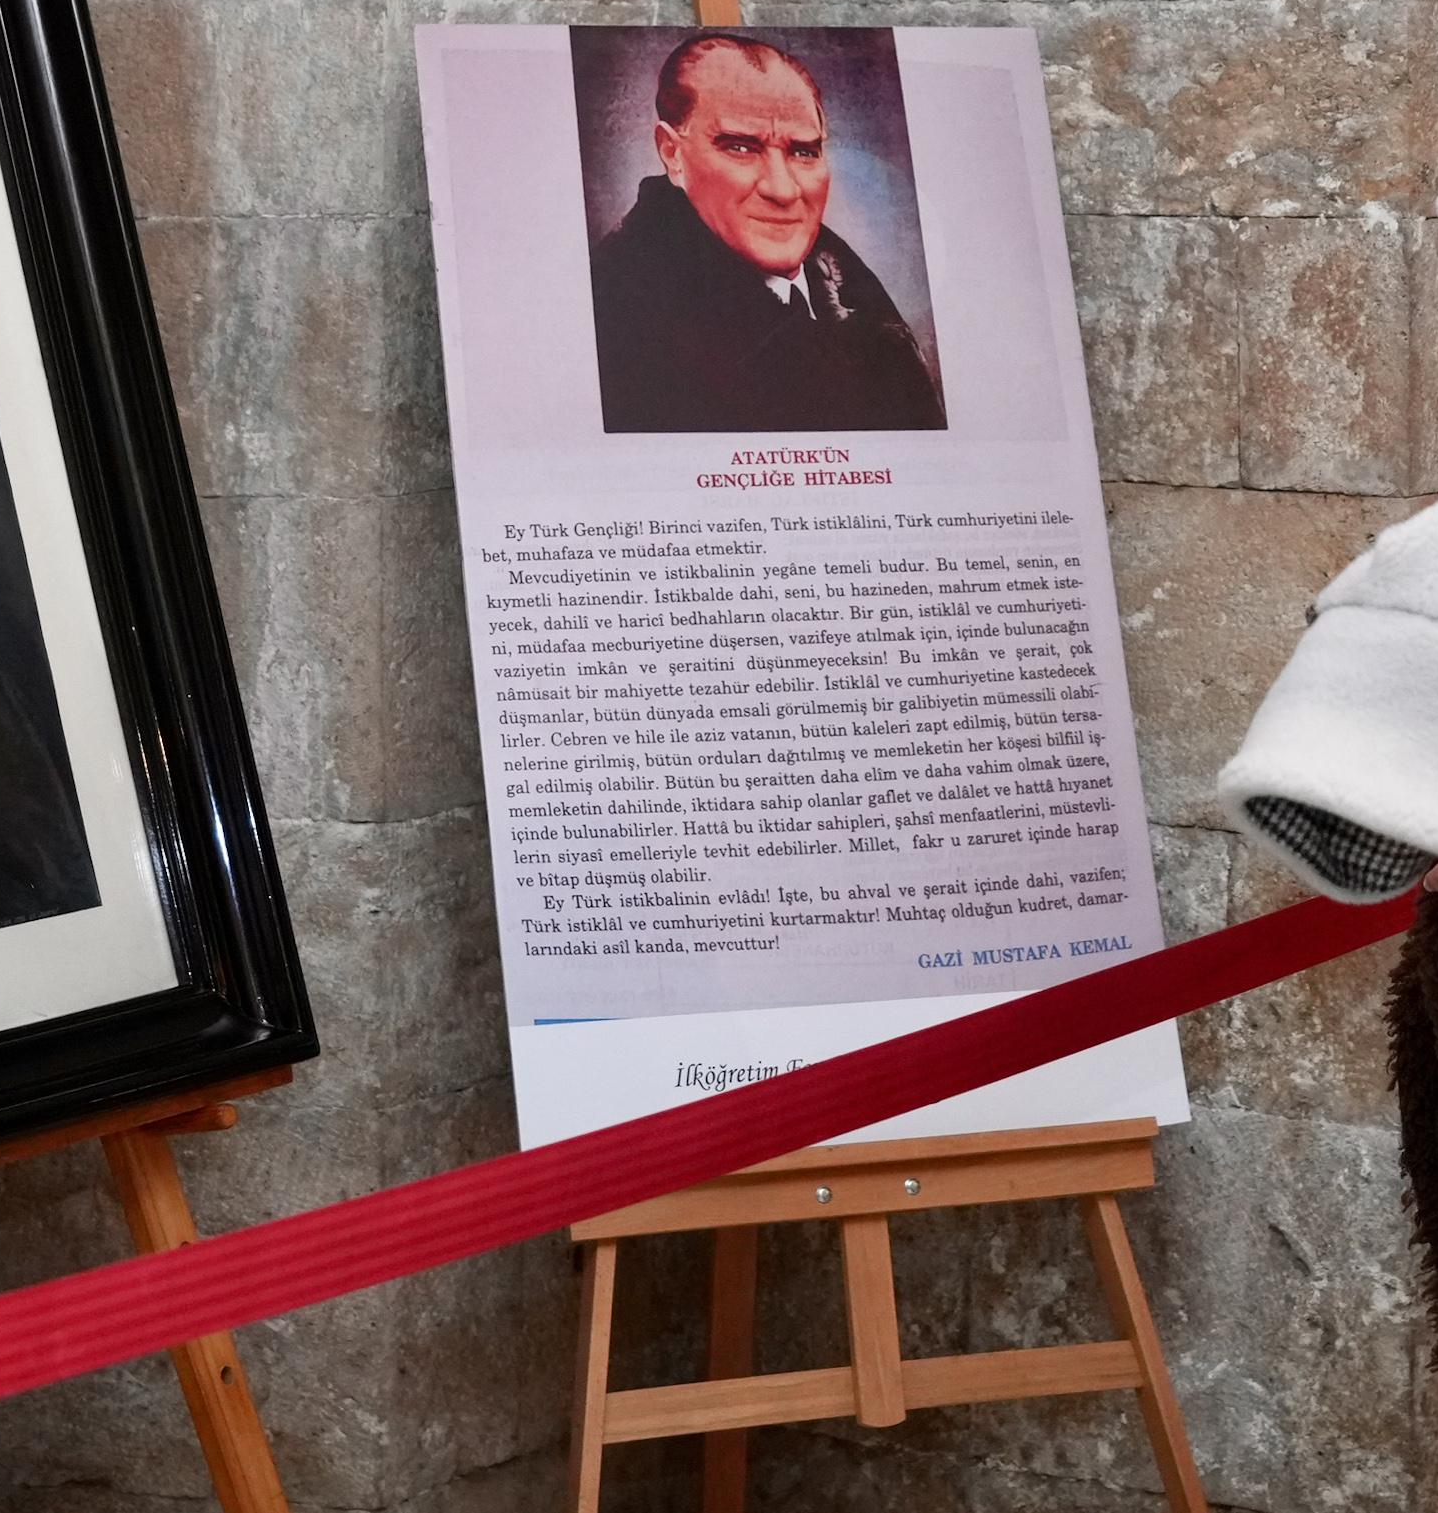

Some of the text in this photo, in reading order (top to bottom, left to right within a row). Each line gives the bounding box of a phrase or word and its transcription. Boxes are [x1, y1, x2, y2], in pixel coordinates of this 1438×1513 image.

[730, 445, 849, 465] ATATÜRK'ÜN
[696, 467, 892, 491] GENÇLİĞE HİTABESİ
[502, 509, 1074, 542] Ey Türk Gençliği! Birinci vazifen, Türk istiklâlini, Türk cumhuriyetini ilele-
[480, 539, 767, 565] bet, muhafaza ve müdafaa etmektir.
[507, 553, 1081, 587] Mevcudiyetinin ve istikbalinin yegâne temeli budur. Bu temel, senin, en
[485, 575, 1083, 612] kıymetli hazinendir. İstikbalde dahi, seni, bu hazineden, mahrum etmek iste-
[488, 596, 1086, 635] yecek, dahilî ve haricî bedhahların olacaktır. Bir gün, istiklâl ve cumhuriyeti-
[490, 618, 1090, 657] ni, müdafaa mecburiyetine düşersen, vazifeye atılmak için, içinde bulunacağın
[492, 638, 1093, 681] vaziyetin imkân ve şeraitini düşünmeyeceksin! Bu imkân ve şerait, çok
[495, 660, 1097, 702] nâmüsait bir mahiyette tezahür edebilir. İstiklâl ve cumhuriyetine kastedecek
[498, 682, 1101, 728] düşmanlar, bütün dünyada emsali görülmemiş bir galibiyetin mümessili olabi-
[502, 729, 1106, 773] nelerine girilmiş, bütün orduları dağıtılmış ve memleketin her köşesi bilfiil iş-
[507, 774, 1113, 818] memleketin dahilinde, iktidara sahip olanlar gaflet ve dalâlet ve hattâ hıyanet
[510, 795, 1116, 845] içinde bulunabilirler. Hattâ bu iktidar sahipleri, şahsî menfaatlerini, müstevli-
[512, 821, 1119, 866] lerin siyasî emelleriyle tevhit edebilirler. Millet, fakr u zaruret içinde harap
[515, 866, 711, 889] ve bîtap düşmüş olabilir.
[520, 891, 1129, 933] Türk istiklâl ve cumhuriyetini kurtarmaktır! Muhtaç olduğun kudret, damar-
[523, 934, 780, 956] larındaki asîl kanda, mevcuttur!
[917, 934, 1133, 969] GAZİ MUSTAFA KEMAL
[674, 1062, 779, 1092] İlköğretim
